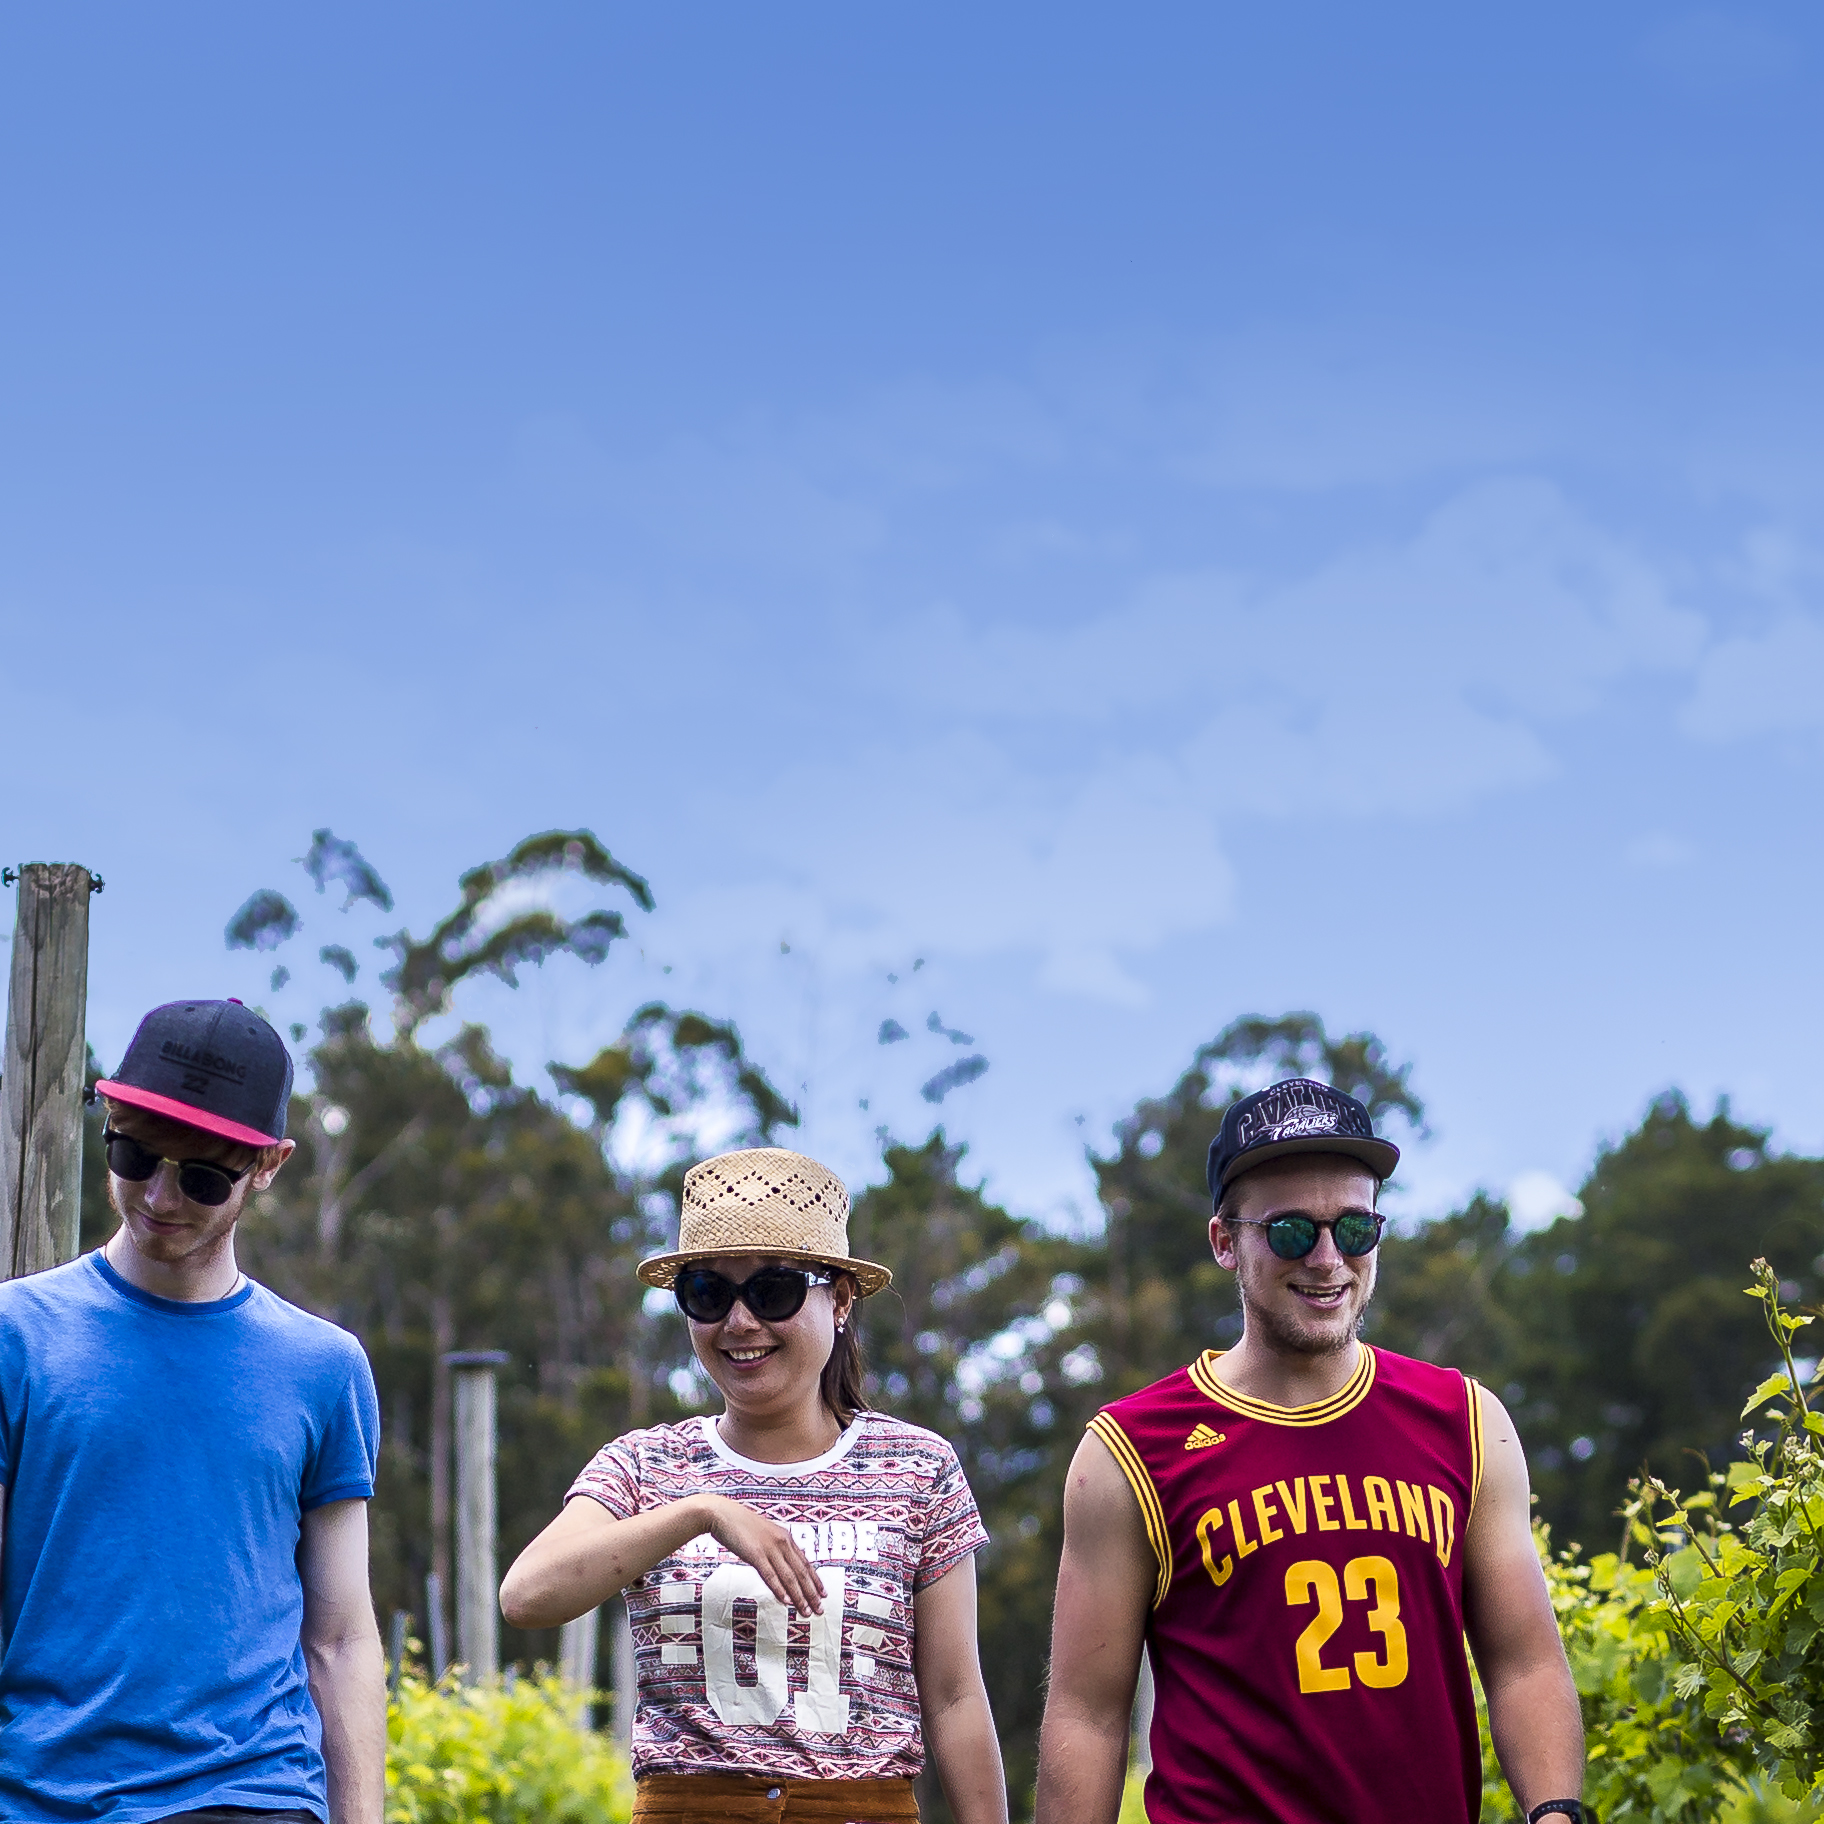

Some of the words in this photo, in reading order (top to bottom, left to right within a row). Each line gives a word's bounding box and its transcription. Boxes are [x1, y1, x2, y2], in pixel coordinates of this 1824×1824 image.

[162, 1041, 247, 1078] BILLABONG
[1270, 1080, 1328, 1096] CLEVELAND
[1184, 1433, 1226, 1450] adidas
[780, 1523, 879, 1561] RIBE
[1196, 1474, 1456, 1587] CLEVELAND
[1284, 1555, 1409, 1694] 23
[701, 1563, 850, 1734] 01
